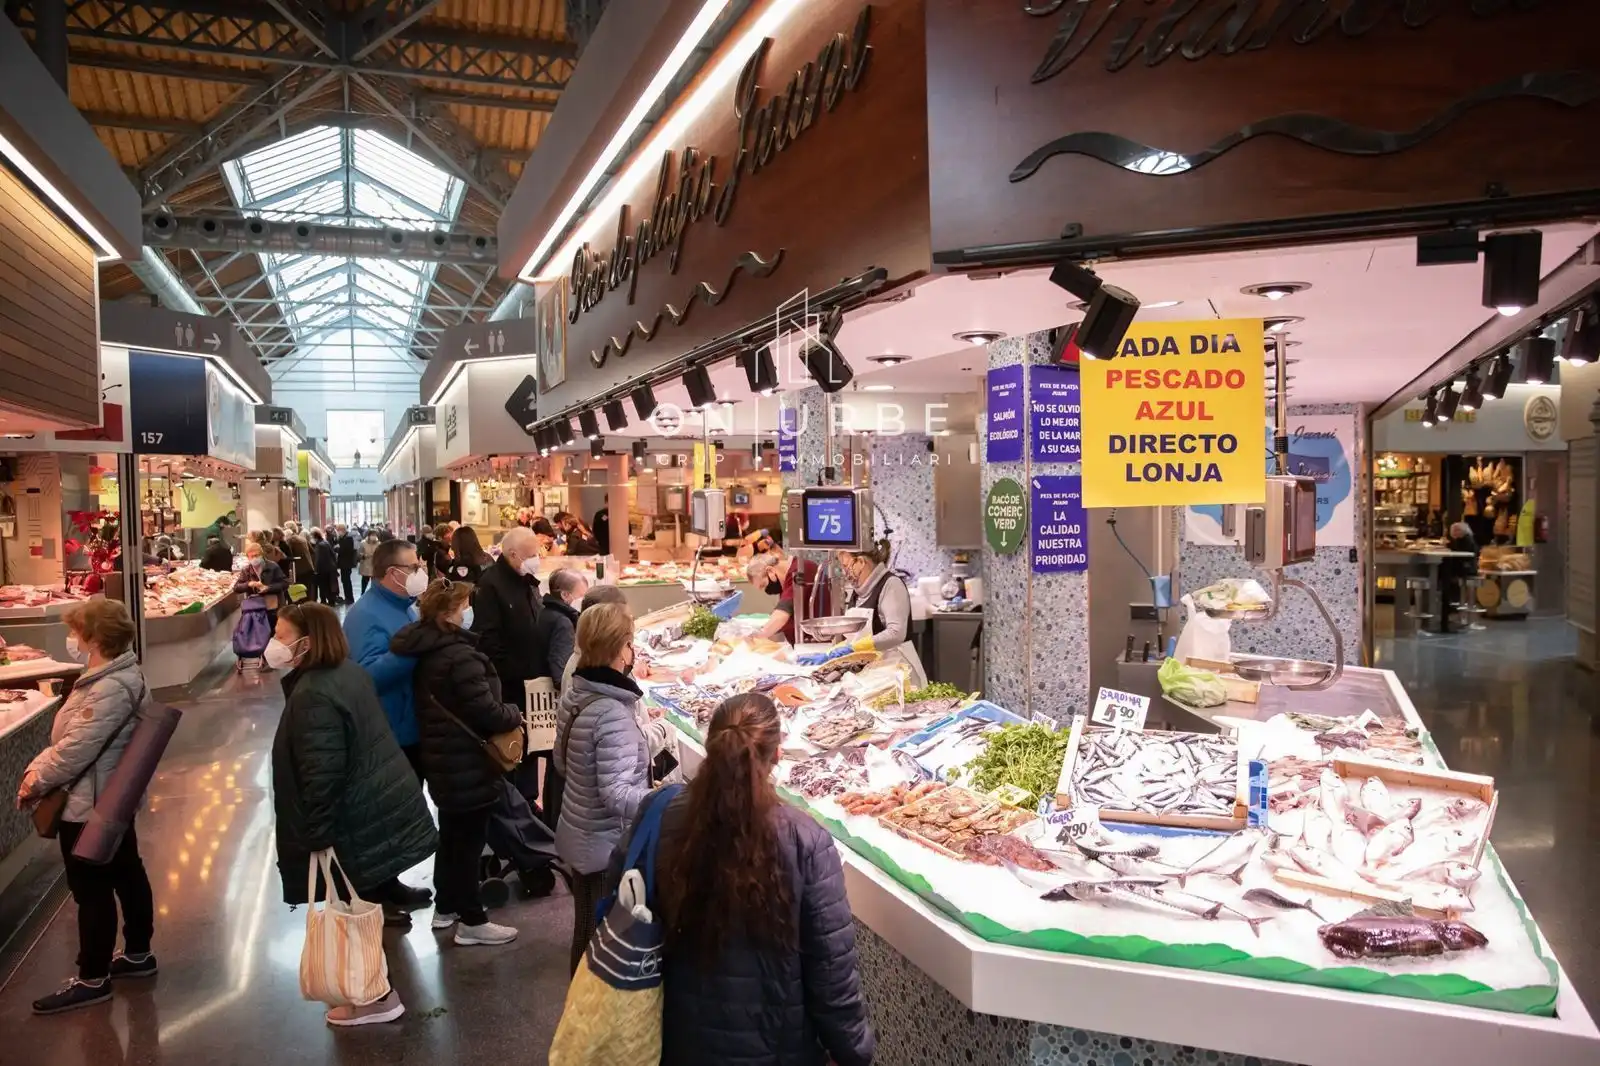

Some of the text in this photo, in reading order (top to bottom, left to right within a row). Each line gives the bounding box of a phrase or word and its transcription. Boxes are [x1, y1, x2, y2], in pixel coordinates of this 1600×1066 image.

[1117, 334, 1241, 357] ADA DIA
[1106, 369, 1245, 389] PESCADO
[1033, 404, 1080, 413] NO SE OLVID
[1135, 401, 1214, 421] AZUL
[993, 408, 1016, 422] SALMÓN
[1040, 418, 1079, 427] LO MEJOR
[141, 432, 163, 444] 157
[989, 428, 1019, 441] ECOLÓGICO
[1039, 431, 1081, 440] DE LA MAR
[1040, 445, 1081, 453] A SU CASA
[1109, 434, 1238, 454] DIRECTO
[1126, 463, 1223, 483] LONJA
[991, 493, 1020, 505] RACÓ DE
[987, 506, 1023, 520] COMERÇ
[1053, 511, 1067, 521] LA
[818, 514, 841, 534] 75
[993, 518, 1017, 530] VERD
[1040, 524, 1080, 535] CALIDAD
[1038, 538, 1082, 549] NUESTRA
[1035, 554, 1086, 565] PRIORIDAD
[529, 712, 557, 721] refo
